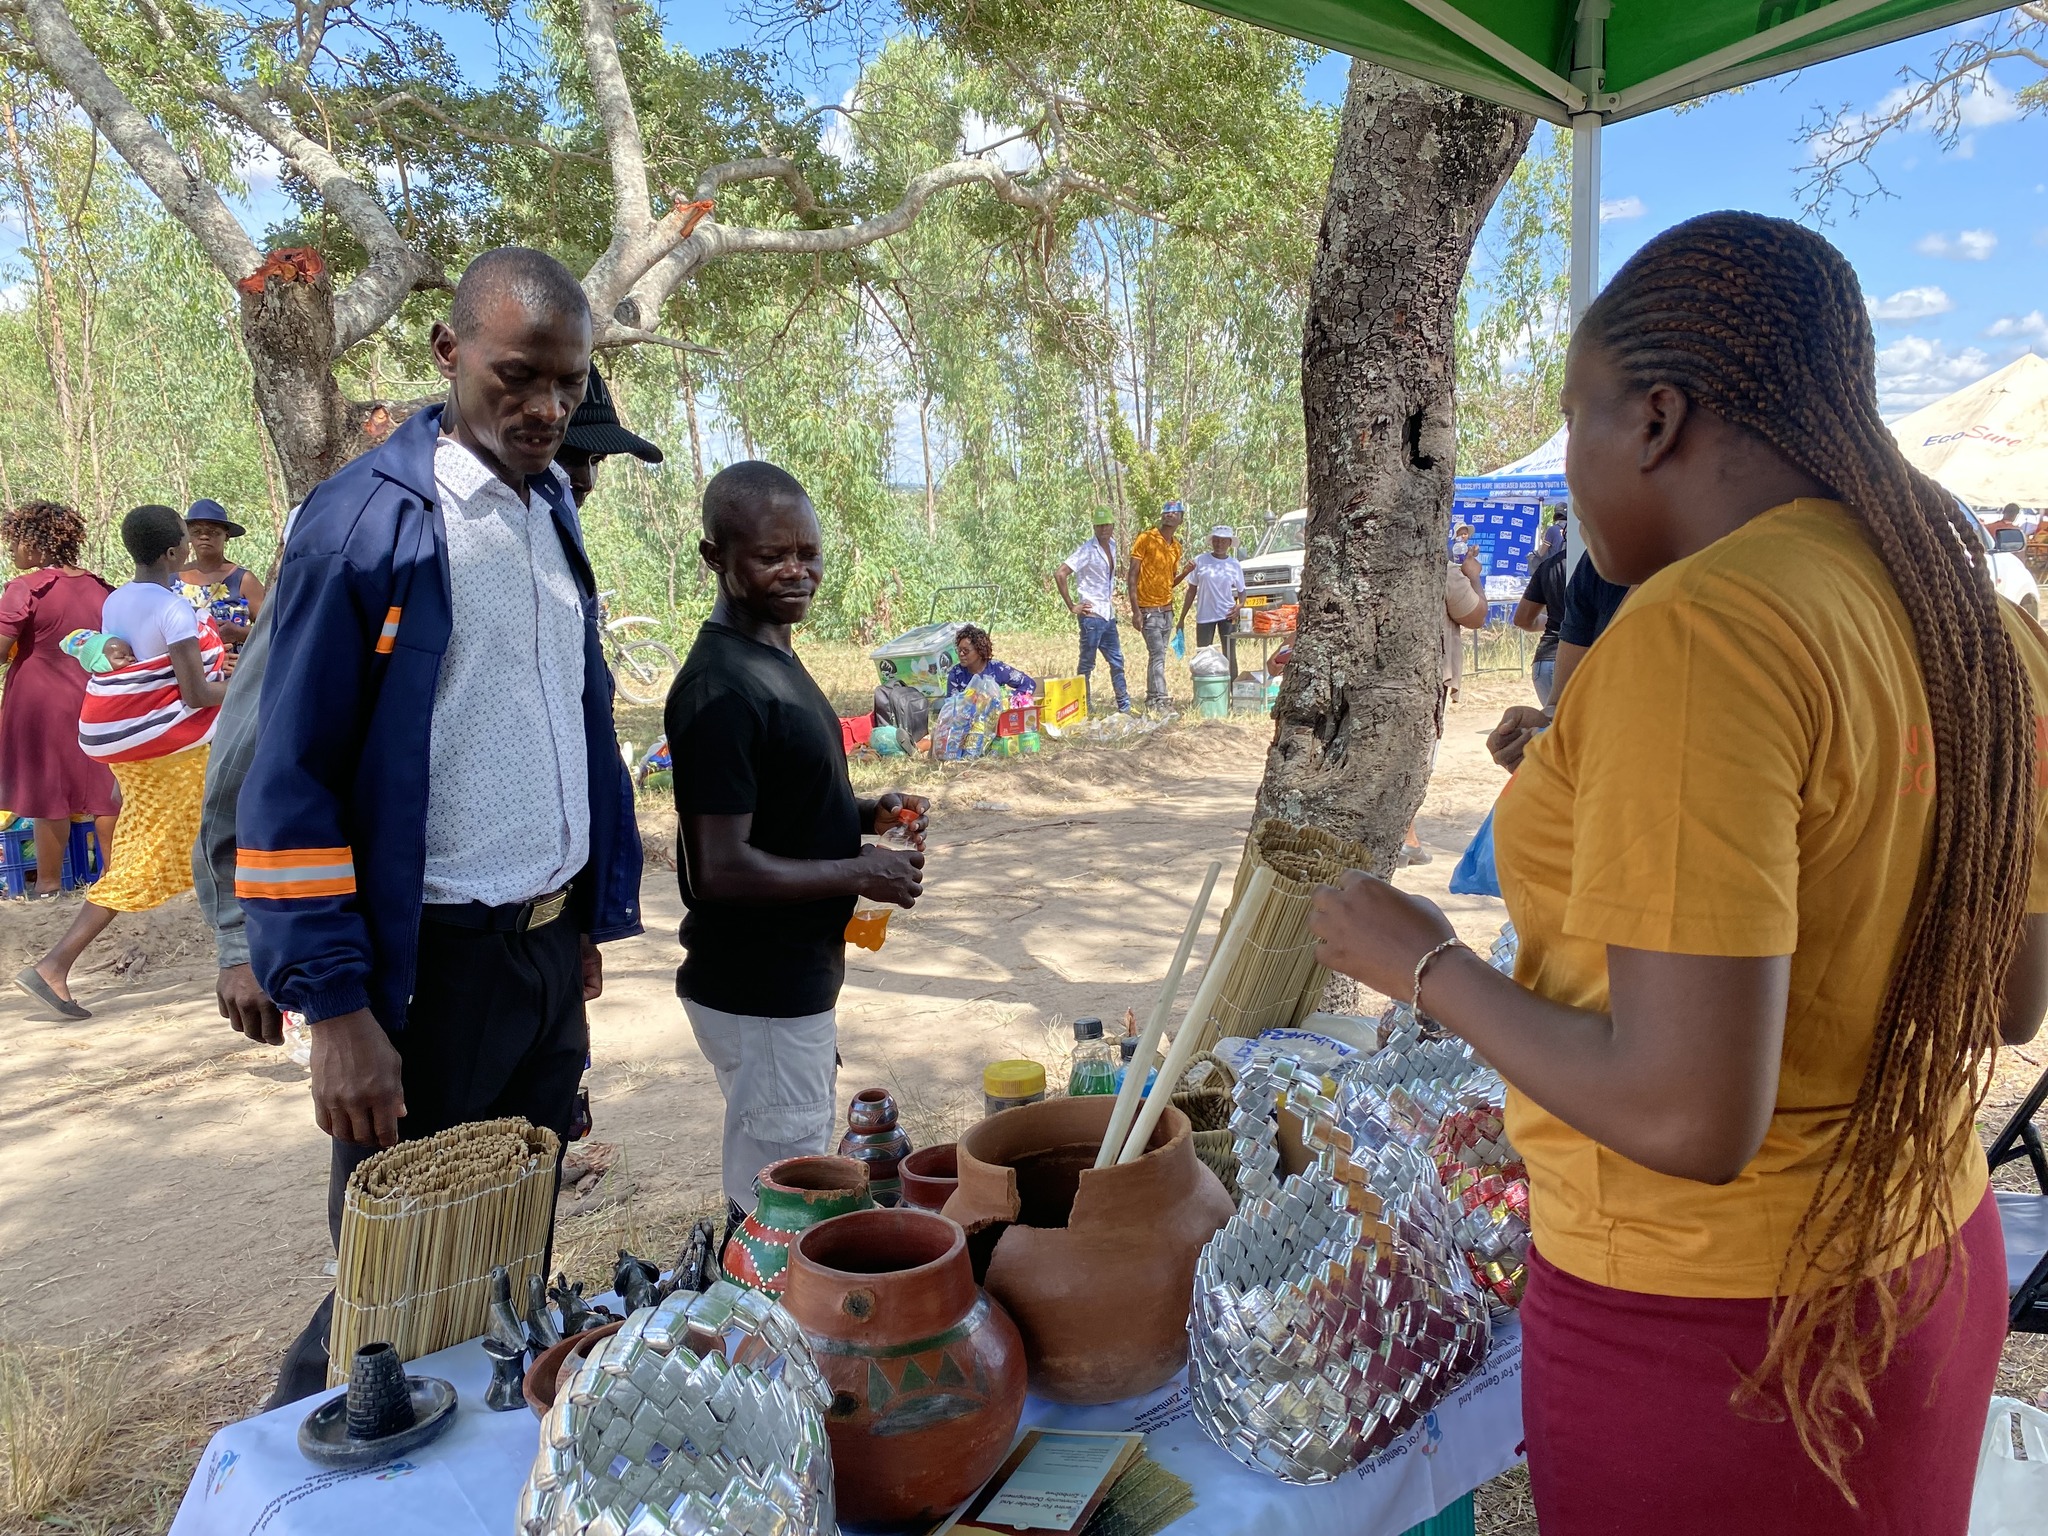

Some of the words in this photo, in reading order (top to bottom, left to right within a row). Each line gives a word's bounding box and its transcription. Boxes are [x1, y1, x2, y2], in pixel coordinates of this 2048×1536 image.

[1501, 1366, 1514, 1380] For
[1473, 1375, 1500, 1396] Gender
[1134, 1392, 1183, 1421] Zimbabwe
[1458, 1390, 1472, 1408] And
[1149, 1400, 1192, 1422] ommunity
[1170, 1413, 1188, 1422] For
[1140, 1420, 1170, 1435] Gend
[1377, 1445, 1408, 1467] Gender
[1357, 1461, 1376, 1480] And
[285, 1482, 333, 1506] Gender
[1000, 1494, 1044, 1502] Development
[261, 1505, 281, 1531] And
